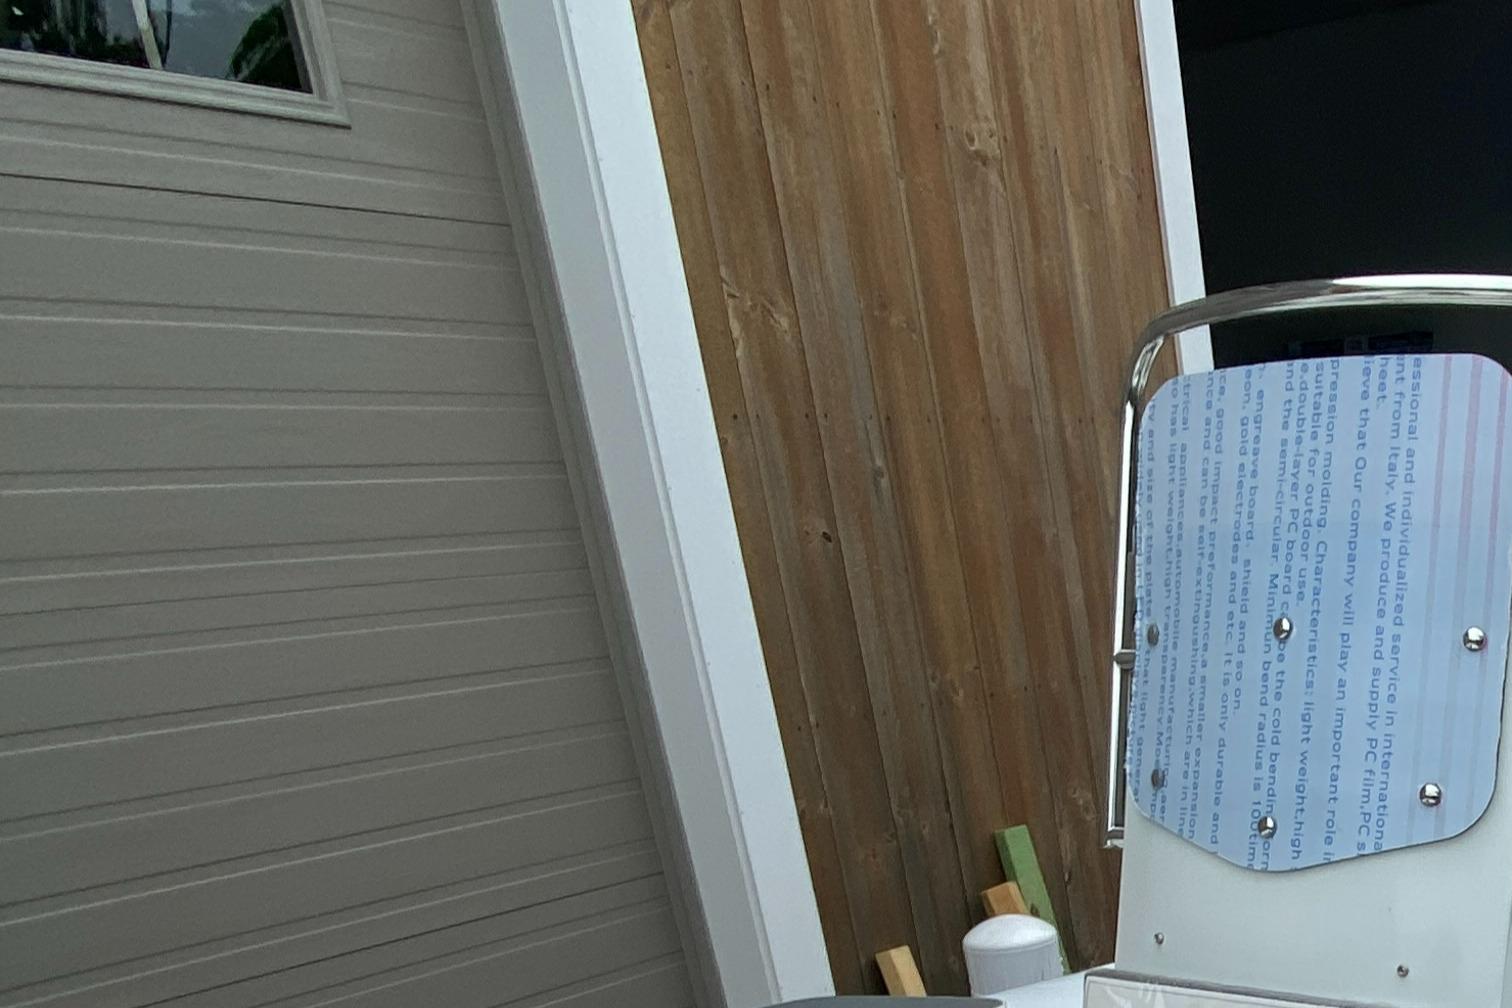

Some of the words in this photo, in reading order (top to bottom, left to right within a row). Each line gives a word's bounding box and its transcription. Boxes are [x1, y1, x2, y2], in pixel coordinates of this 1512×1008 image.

[1282, 399, 1292, 430] the
[1310, 362, 1325, 440] suitable
[1390, 391, 1405, 438] from
[1203, 416, 1211, 449] and
[1214, 408, 1225, 453] good
[1238, 416, 1249, 455] gold
[1356, 407, 1371, 450] that
[1201, 457, 1209, 488] can
[1306, 448, 1319, 477] for
[1353, 456, 1367, 492] Our
[1385, 446, 1401, 495] Italy.
[1404, 448, 1417, 483] and
[1199, 496, 1207, 517] be
[1210, 461, 1221, 524] impact
[1231, 462, 1246, 563] electrodes
[1287, 508, 1299, 533] PC
[1300, 483, 1315, 561] outdoor
[1383, 502, 1397, 530] We
[1344, 498, 1362, 586] company
[1392, 490, 1414, 626] individualized
[1240, 559, 1252, 613] shield
[1282, 540, 1296, 594] board
[1375, 538, 1394, 618] produce
[1228, 571, 1238, 603] and
[1342, 593, 1356, 624] will
[1237, 620, 1247, 653] and
[1337, 632, 1352, 671] play
[1373, 625, 1387, 660] and
[1222, 672, 1231, 686] is
[1235, 660, 1243, 680] so
[1259, 661, 1272, 706] bend
[1274, 670, 1285, 700] the
[1386, 633, 1402, 703] service
[1196, 675, 1207, 741] smaller
[1336, 678, 1347, 700] an
[1366, 667, 1383, 730] supply
[1218, 693, 1229, 731] only
[1271, 707, 1282, 745] cold
[1300, 701, 1314, 743] light
[1385, 710, 1396, 726] in
[1254, 713, 1267, 770] radius
[1327, 707, 1345, 803] important
[1364, 737, 1378, 762] PC
[1182, 751, 1191, 779] are
[1213, 737, 1226, 806] durable
[1253, 777, 1263, 791] is
[1181, 786, 1189, 800] in
[1210, 812, 1220, 844] and
[1324, 809, 1338, 845] role
